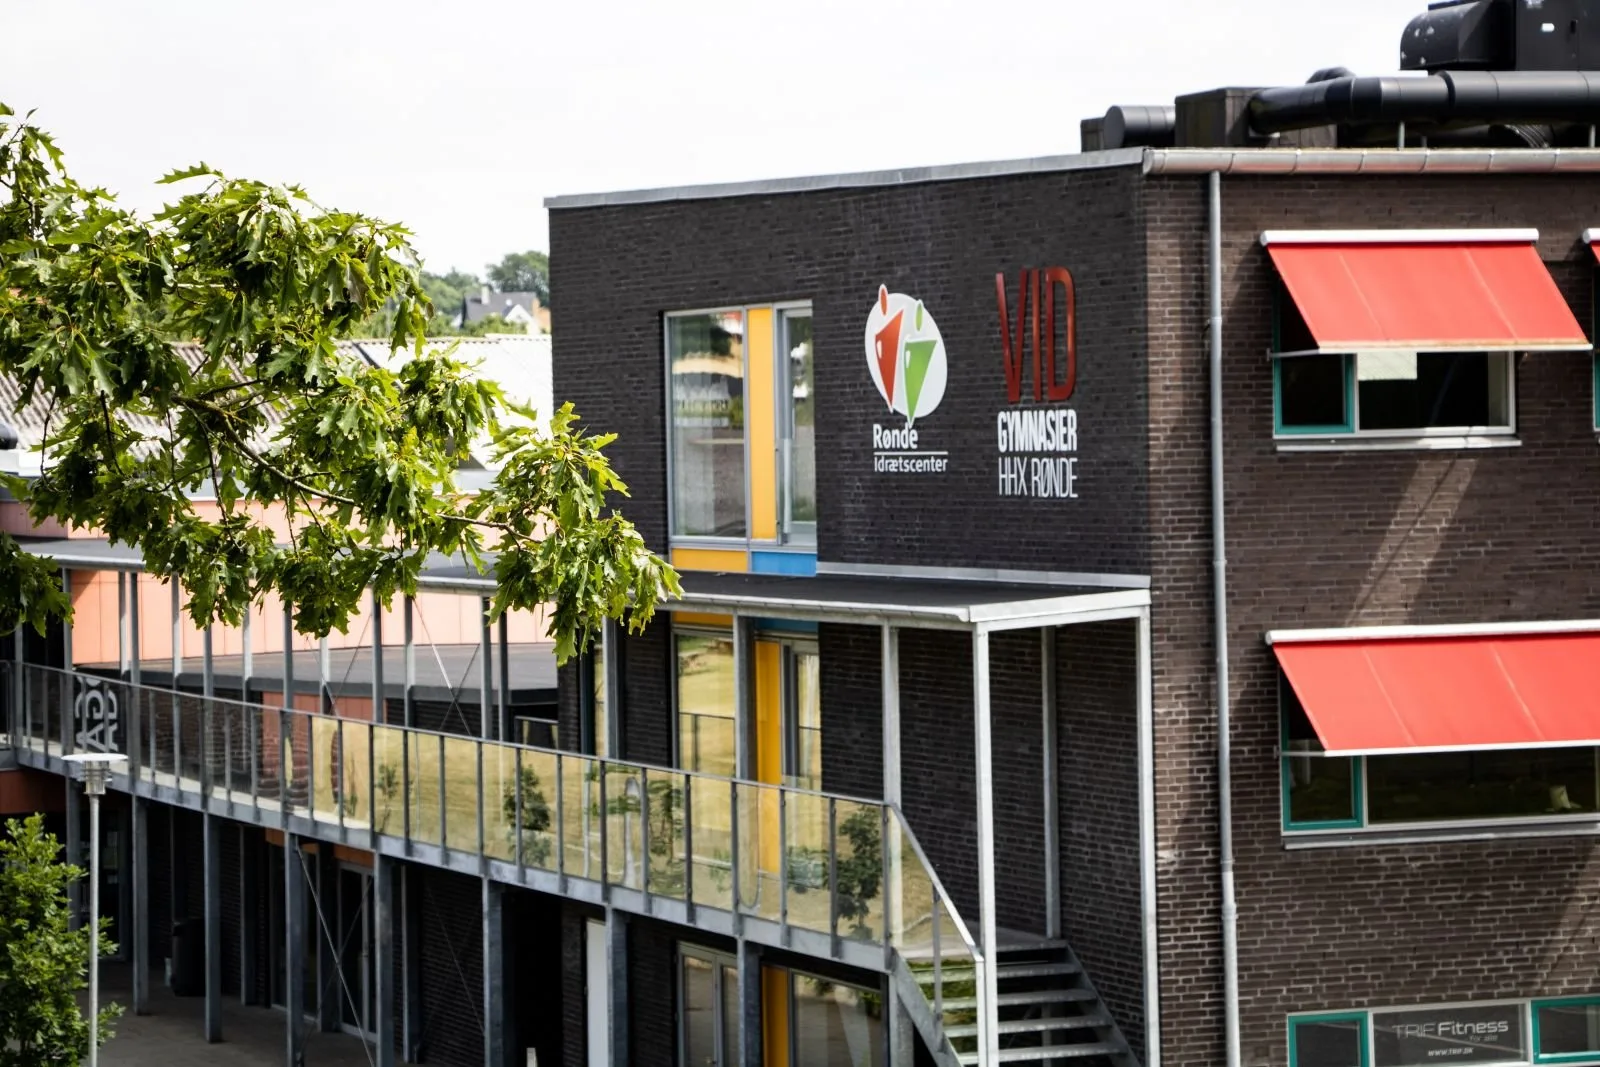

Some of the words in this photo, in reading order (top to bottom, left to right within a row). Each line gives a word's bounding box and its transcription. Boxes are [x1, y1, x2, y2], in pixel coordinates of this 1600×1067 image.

[996, 265, 1077, 403] VID
[872, 423, 919, 450] Rønde
[997, 409, 1077, 453] GYMNASIER
[873, 455, 948, 473] Idrætscenter
[998, 457, 1029, 496] HHX
[1031, 458, 1078, 498] RØNDE
[1438, 1020, 1509, 1036] Fitness
